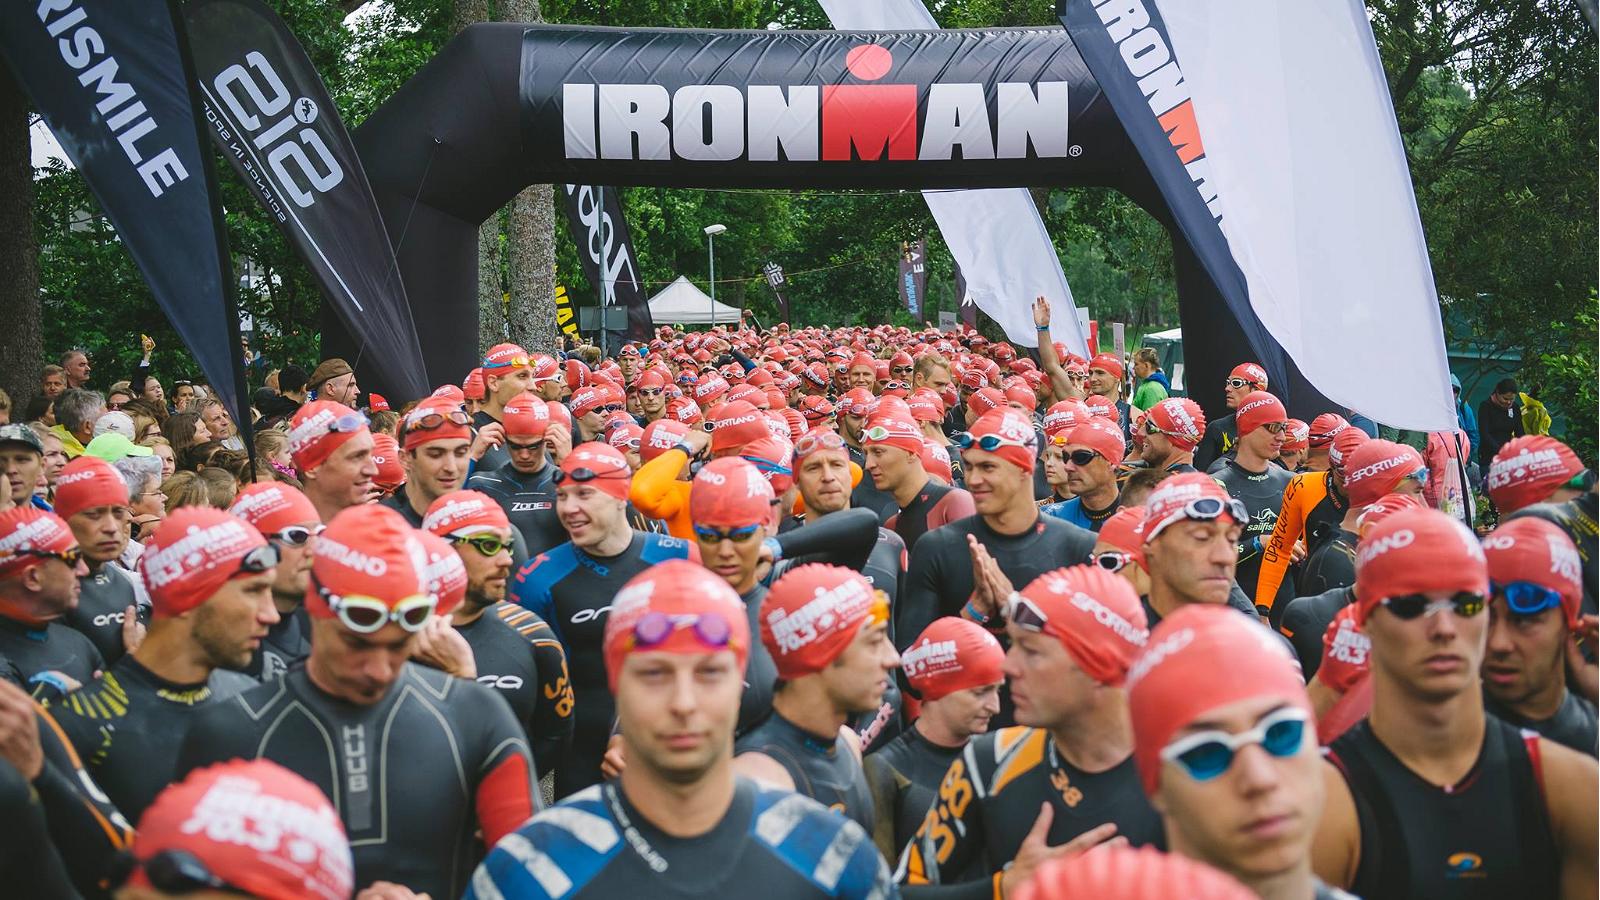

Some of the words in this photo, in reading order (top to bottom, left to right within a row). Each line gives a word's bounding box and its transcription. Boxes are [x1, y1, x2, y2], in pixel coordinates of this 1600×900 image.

[563, 82, 1068, 161] IRONMAN
[648, 439, 673, 449] 70.3
[1351, 452, 1413, 482] SPORTLAND
[1328, 644, 1369, 664] 70.3
[342, 724, 368, 793] HUUB
